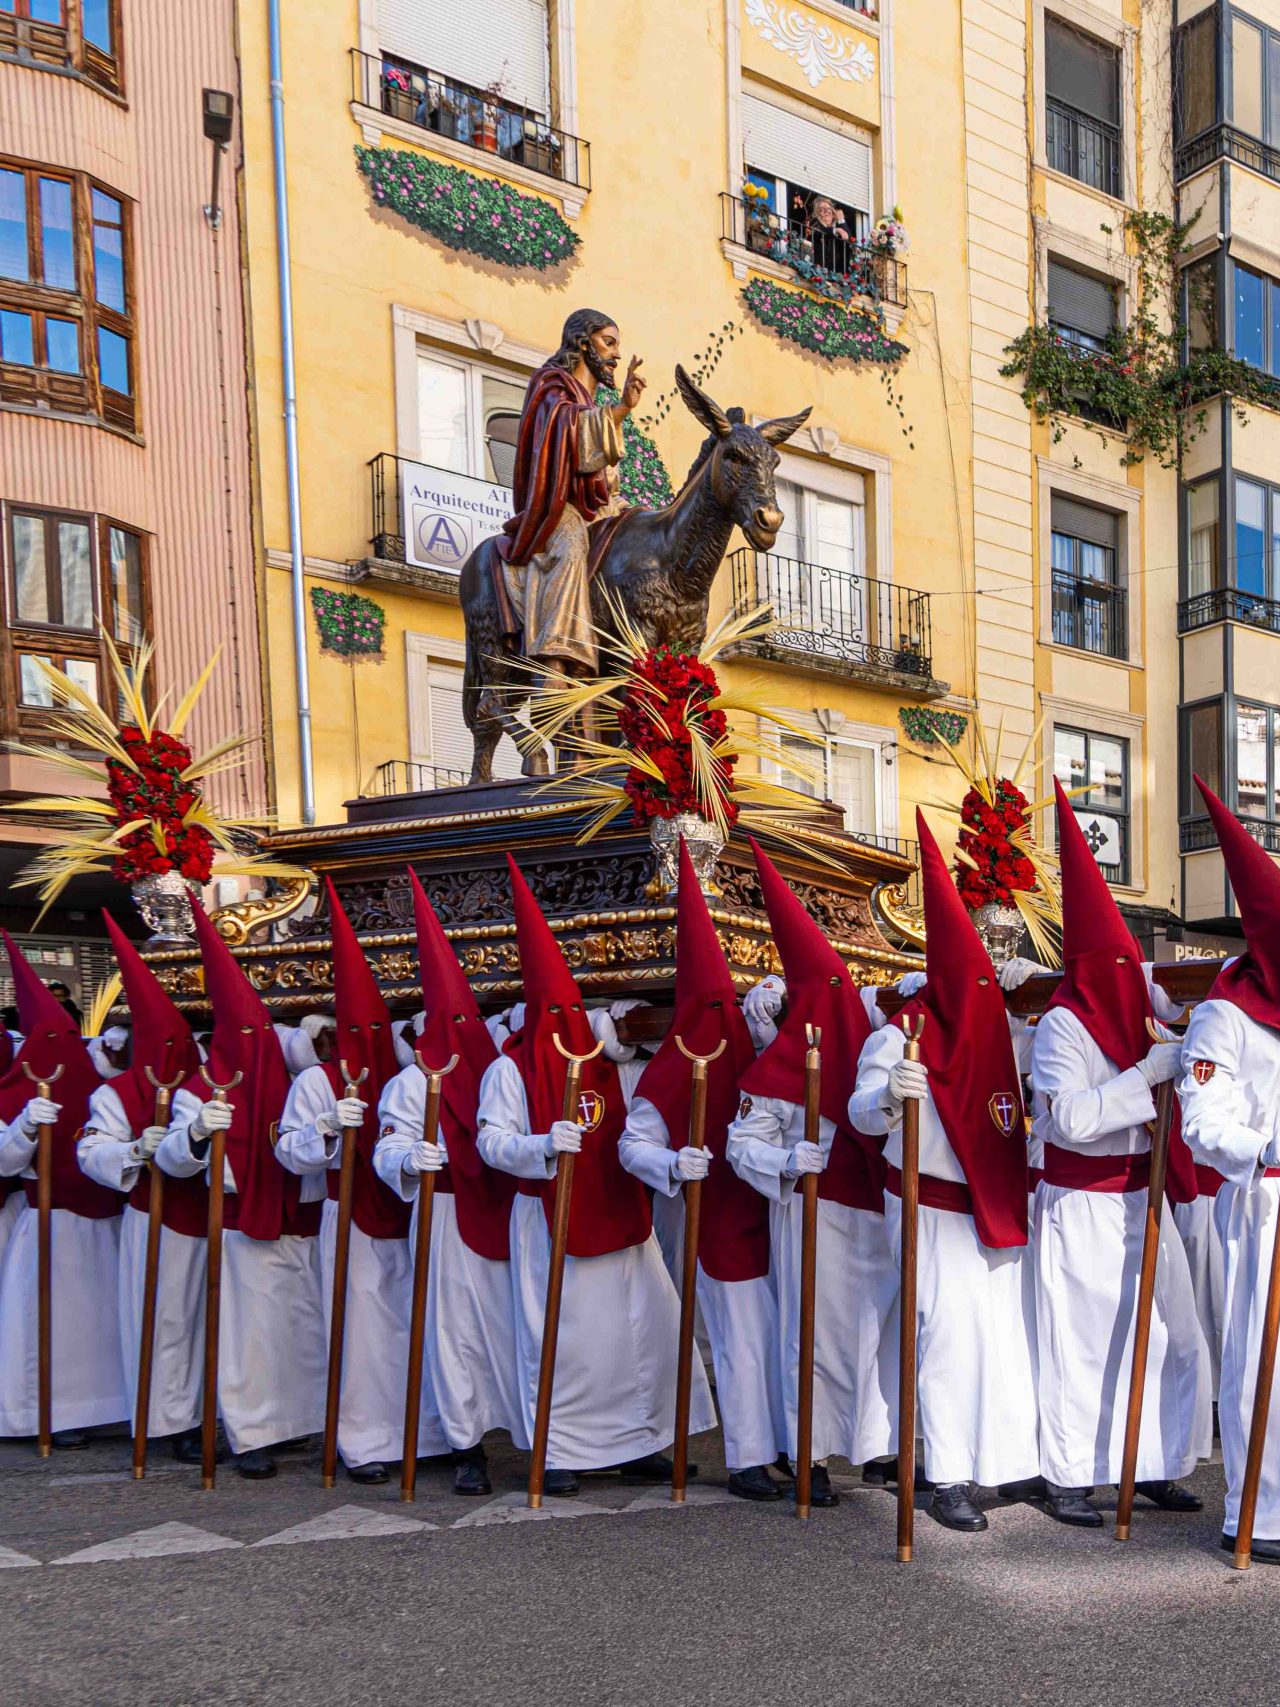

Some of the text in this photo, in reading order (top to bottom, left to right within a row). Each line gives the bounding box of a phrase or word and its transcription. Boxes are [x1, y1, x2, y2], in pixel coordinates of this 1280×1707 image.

[410, 484, 511, 520] Arquitectura
[488, 489, 511, 504] AT
[490, 523, 501, 533] 65
